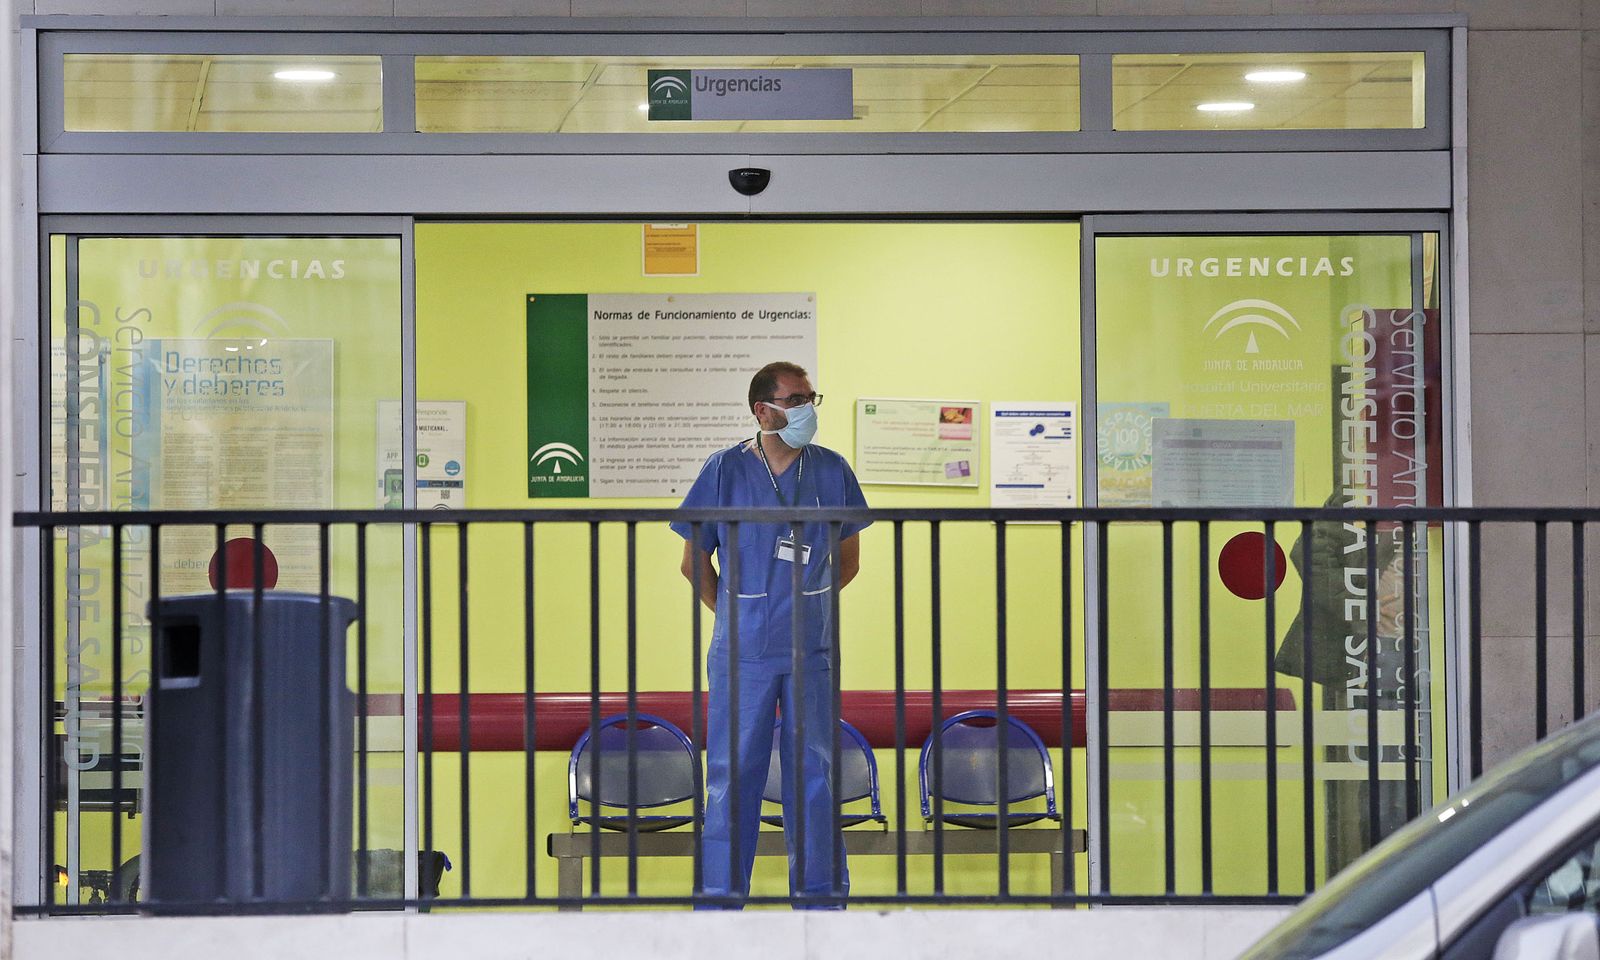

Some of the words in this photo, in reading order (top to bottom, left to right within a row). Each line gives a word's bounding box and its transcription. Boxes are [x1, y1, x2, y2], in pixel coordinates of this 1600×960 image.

[695, 76, 781, 96] Urgencias
[138, 259, 346, 280] URGENCIAS
[1151, 256, 1354, 277] URGENCIAS
[593, 310, 633, 321] Normas
[637, 309, 650, 320] de
[655, 309, 736, 320] Funcionamiento
[741, 309, 754, 320] de
[759, 309, 812, 322] Urgencias:
[115, 306, 152, 438] Servicio
[166, 351, 282, 374] Derechos
[1204, 359, 1232, 370] JUNTA
[1237, 359, 1249, 370] DE
[1252, 359, 1303, 370] ANDALUCIA
[1390, 308, 1427, 439] Servicio
[164, 378, 176, 396] y
[183, 374, 284, 396] deberes
[1241, 380, 1325, 393] Universitario
[1253, 403, 1281, 417] DEL
[1288, 403, 1324, 417] MAR
[64, 300, 100, 554] CONSEJERA
[1115, 428, 1139, 444] 100
[1340, 304, 1379, 555] CONSEJERA
[66, 566, 100, 623] DE
[1344, 566, 1381, 623] DE
[64, 636, 101, 771] SALUD
[1345, 636, 1384, 763] SALUD
